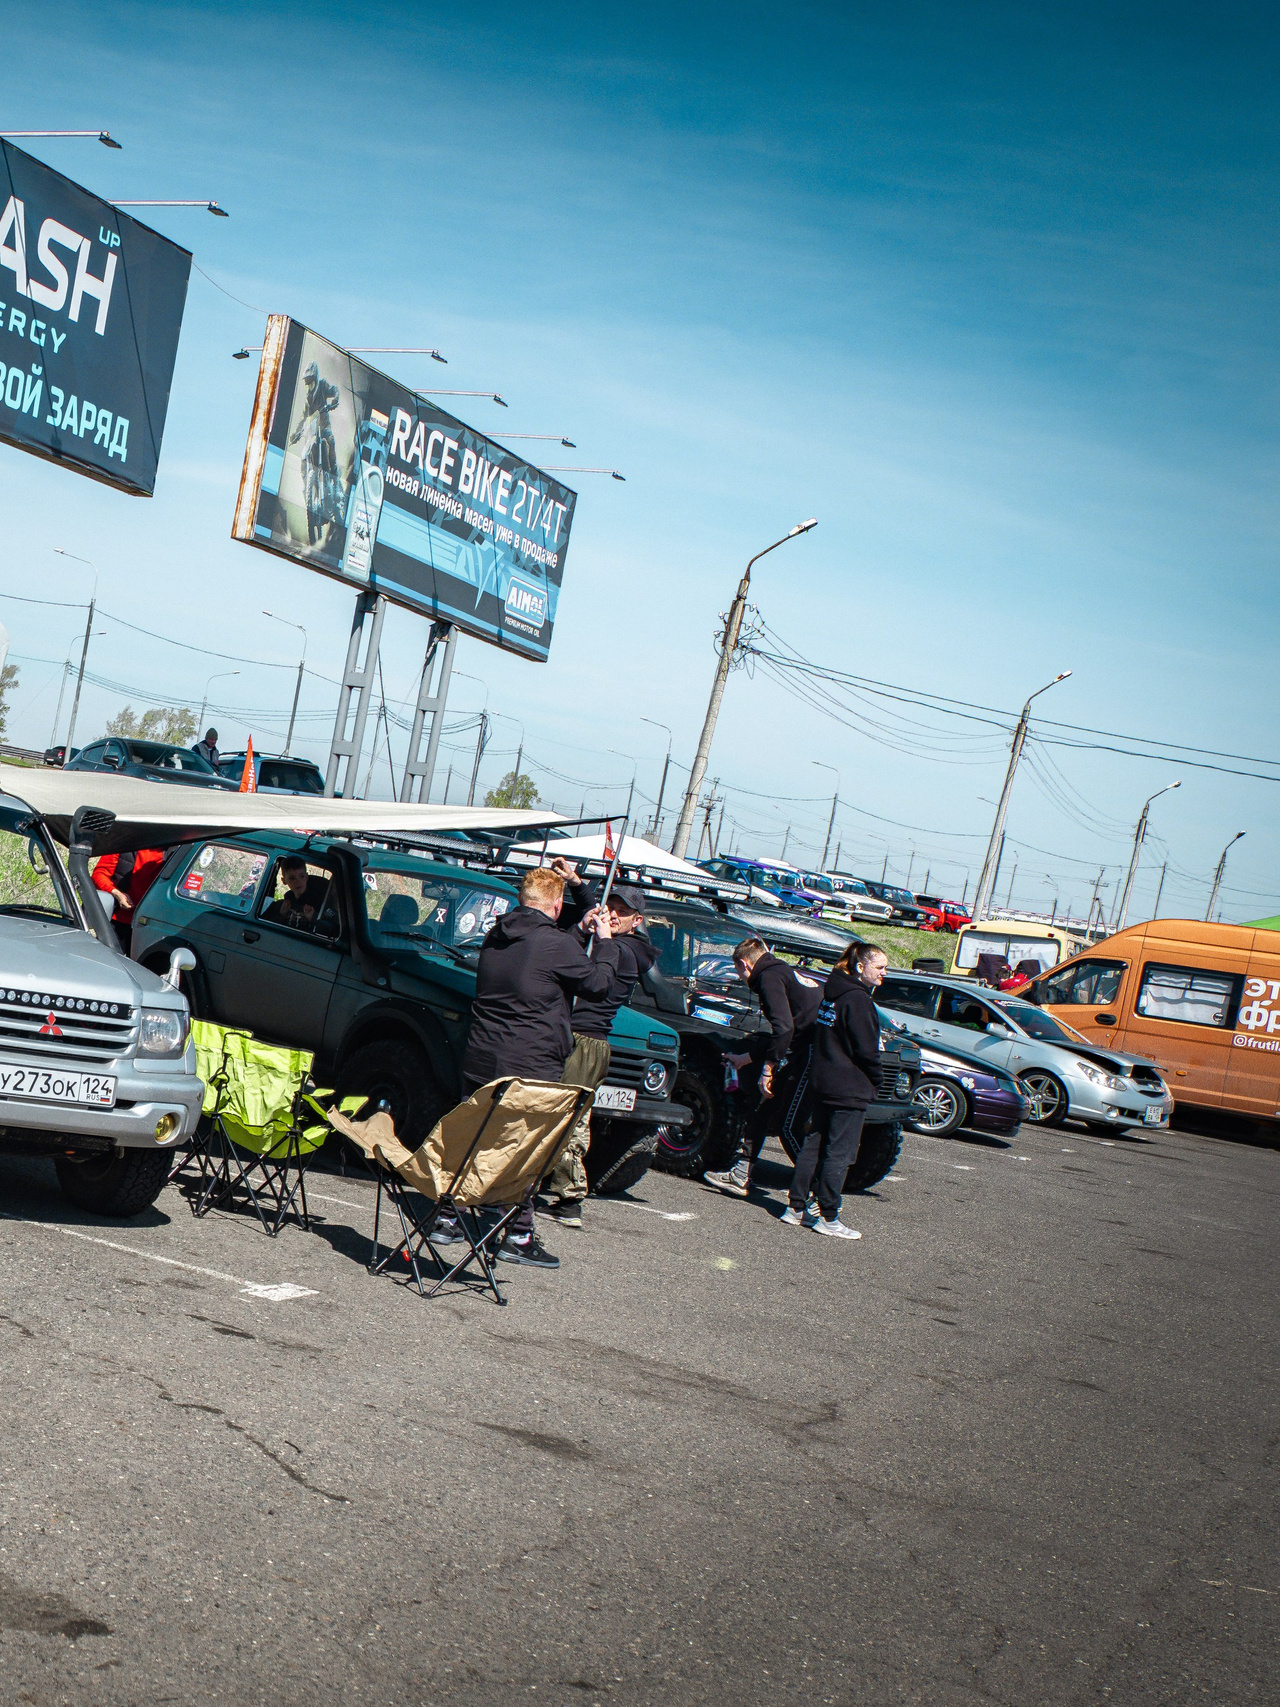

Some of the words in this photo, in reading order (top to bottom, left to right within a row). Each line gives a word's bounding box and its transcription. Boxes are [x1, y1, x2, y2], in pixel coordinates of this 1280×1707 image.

[98, 226, 121, 247] UP
[46, 385, 130, 463] ЗАРЯД
[390, 408, 459, 486] RACE
[458, 448, 513, 516] BIKE
[512, 480, 568, 544] 2T/4T
[385, 465, 419, 496] новая
[420, 483, 463, 520] линейка
[464, 508, 494, 535] масел
[494, 522, 513, 545] уже
[514, 533, 520, 549] в
[521, 536, 558, 568] продаже
[507, 586, 544, 616] AIMOL
[520, 622, 534, 635] MOTOR
[1, 1070, 77, 1098] У273ОК
[83, 1077, 109, 1096] 124
[86, 1093, 100, 1101] RUS
